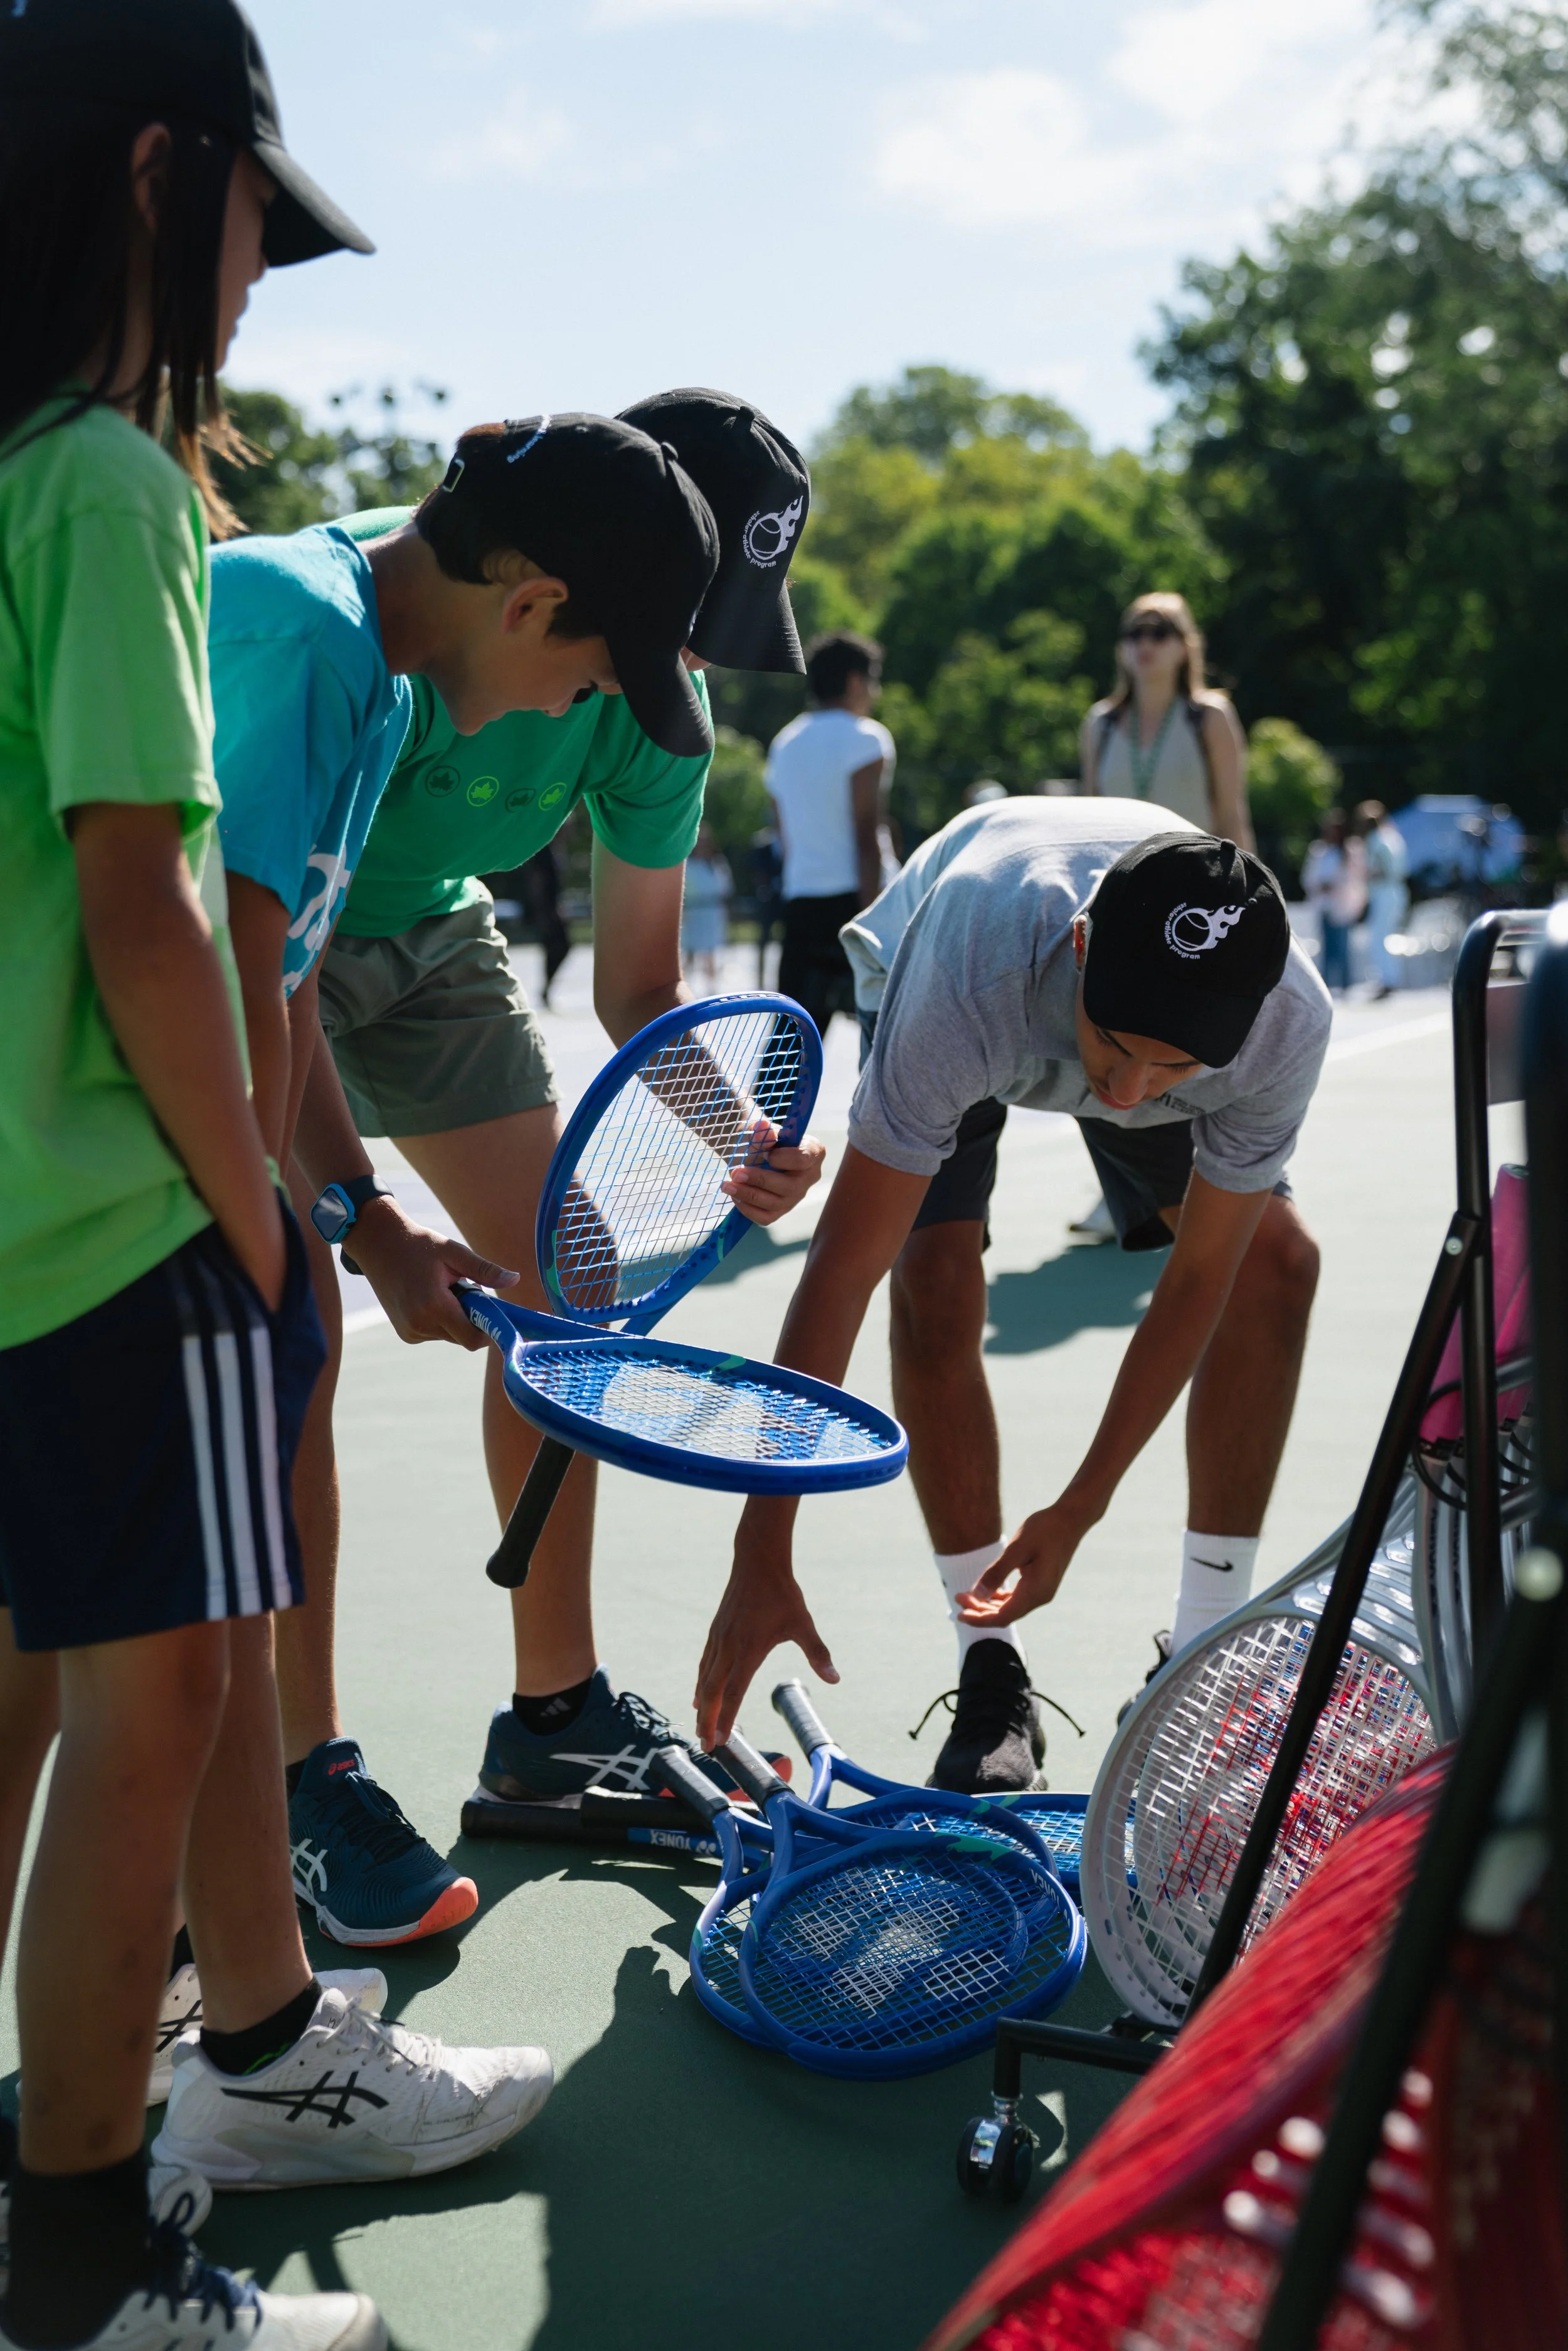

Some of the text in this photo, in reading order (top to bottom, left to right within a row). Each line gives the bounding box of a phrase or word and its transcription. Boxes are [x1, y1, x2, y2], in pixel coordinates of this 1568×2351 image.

[743, 511, 776, 569] scholar athlete program
[1168, 902, 1187, 921] scholar
[1169, 945, 1200, 960] program
[650, 1830, 691, 1850] YONEX
